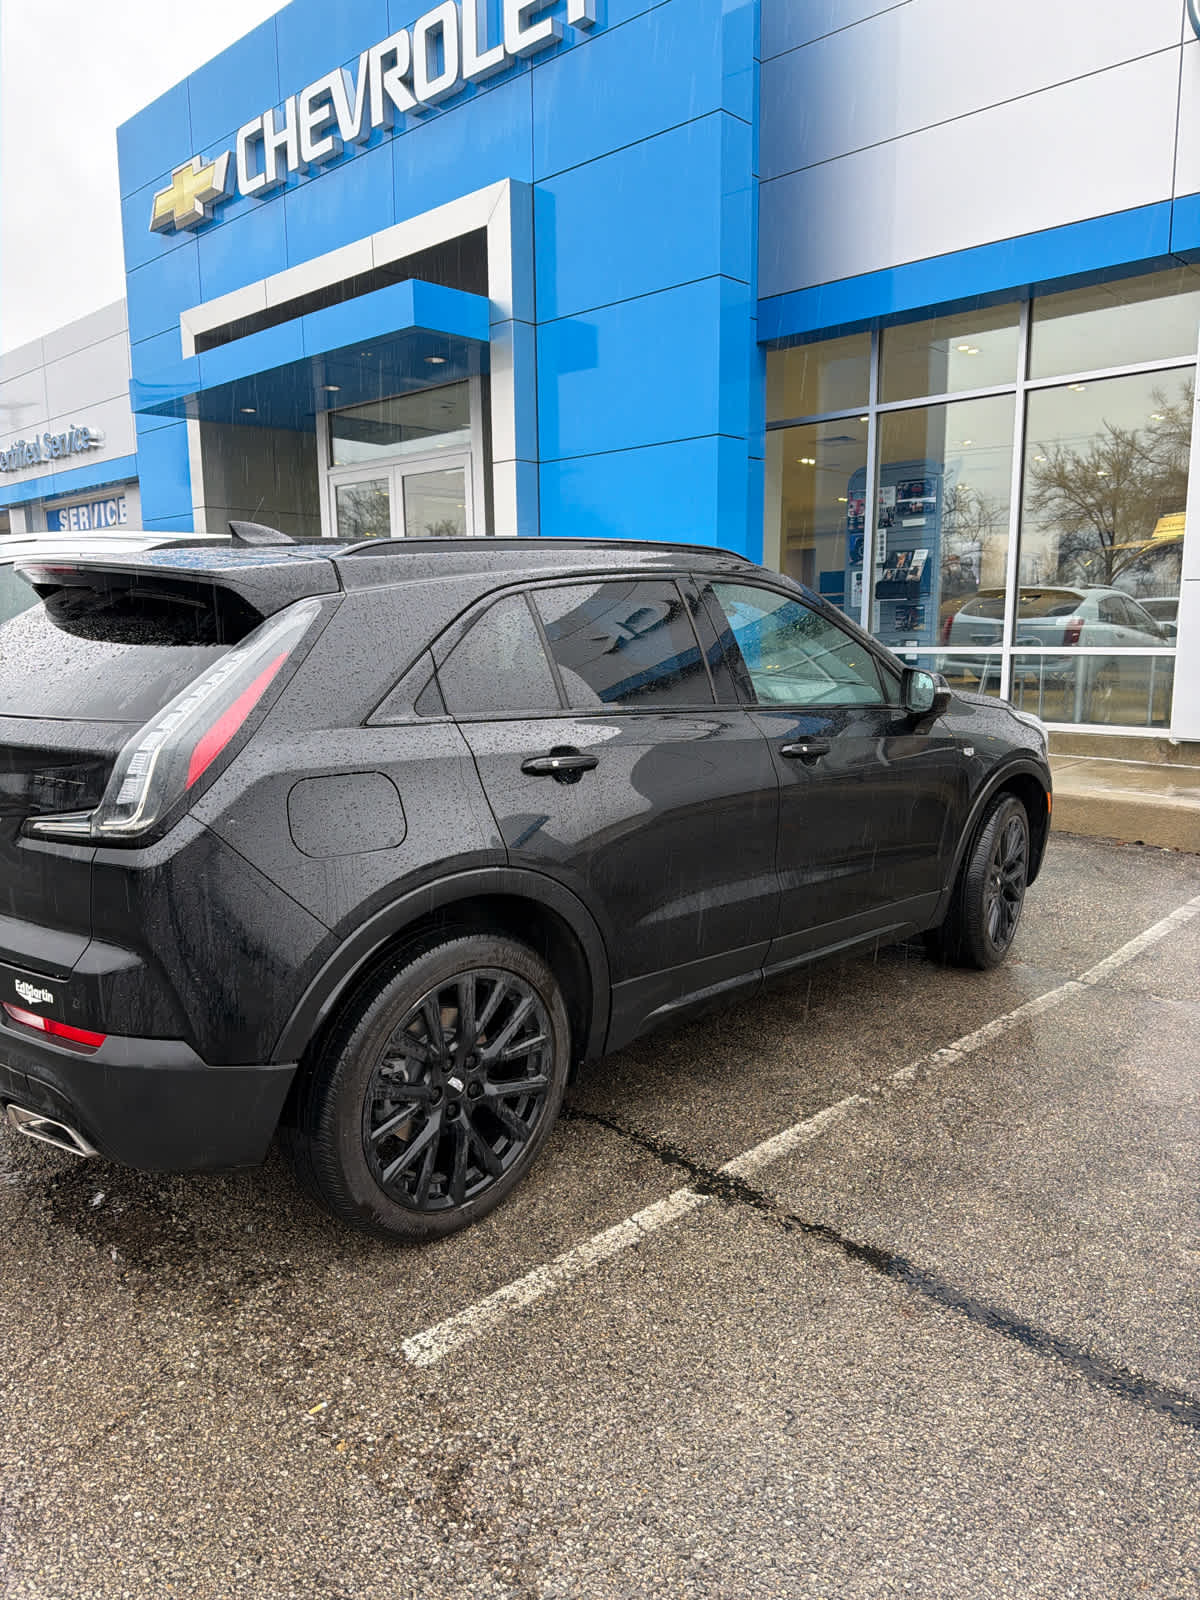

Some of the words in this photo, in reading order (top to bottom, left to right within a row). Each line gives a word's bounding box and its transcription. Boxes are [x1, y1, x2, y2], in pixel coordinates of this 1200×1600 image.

[235, 0, 598, 197] CHEVROLE
[0, 434, 41, 472] ertified
[43, 423, 92, 460] Service
[58, 499, 128, 531] SERVICE
